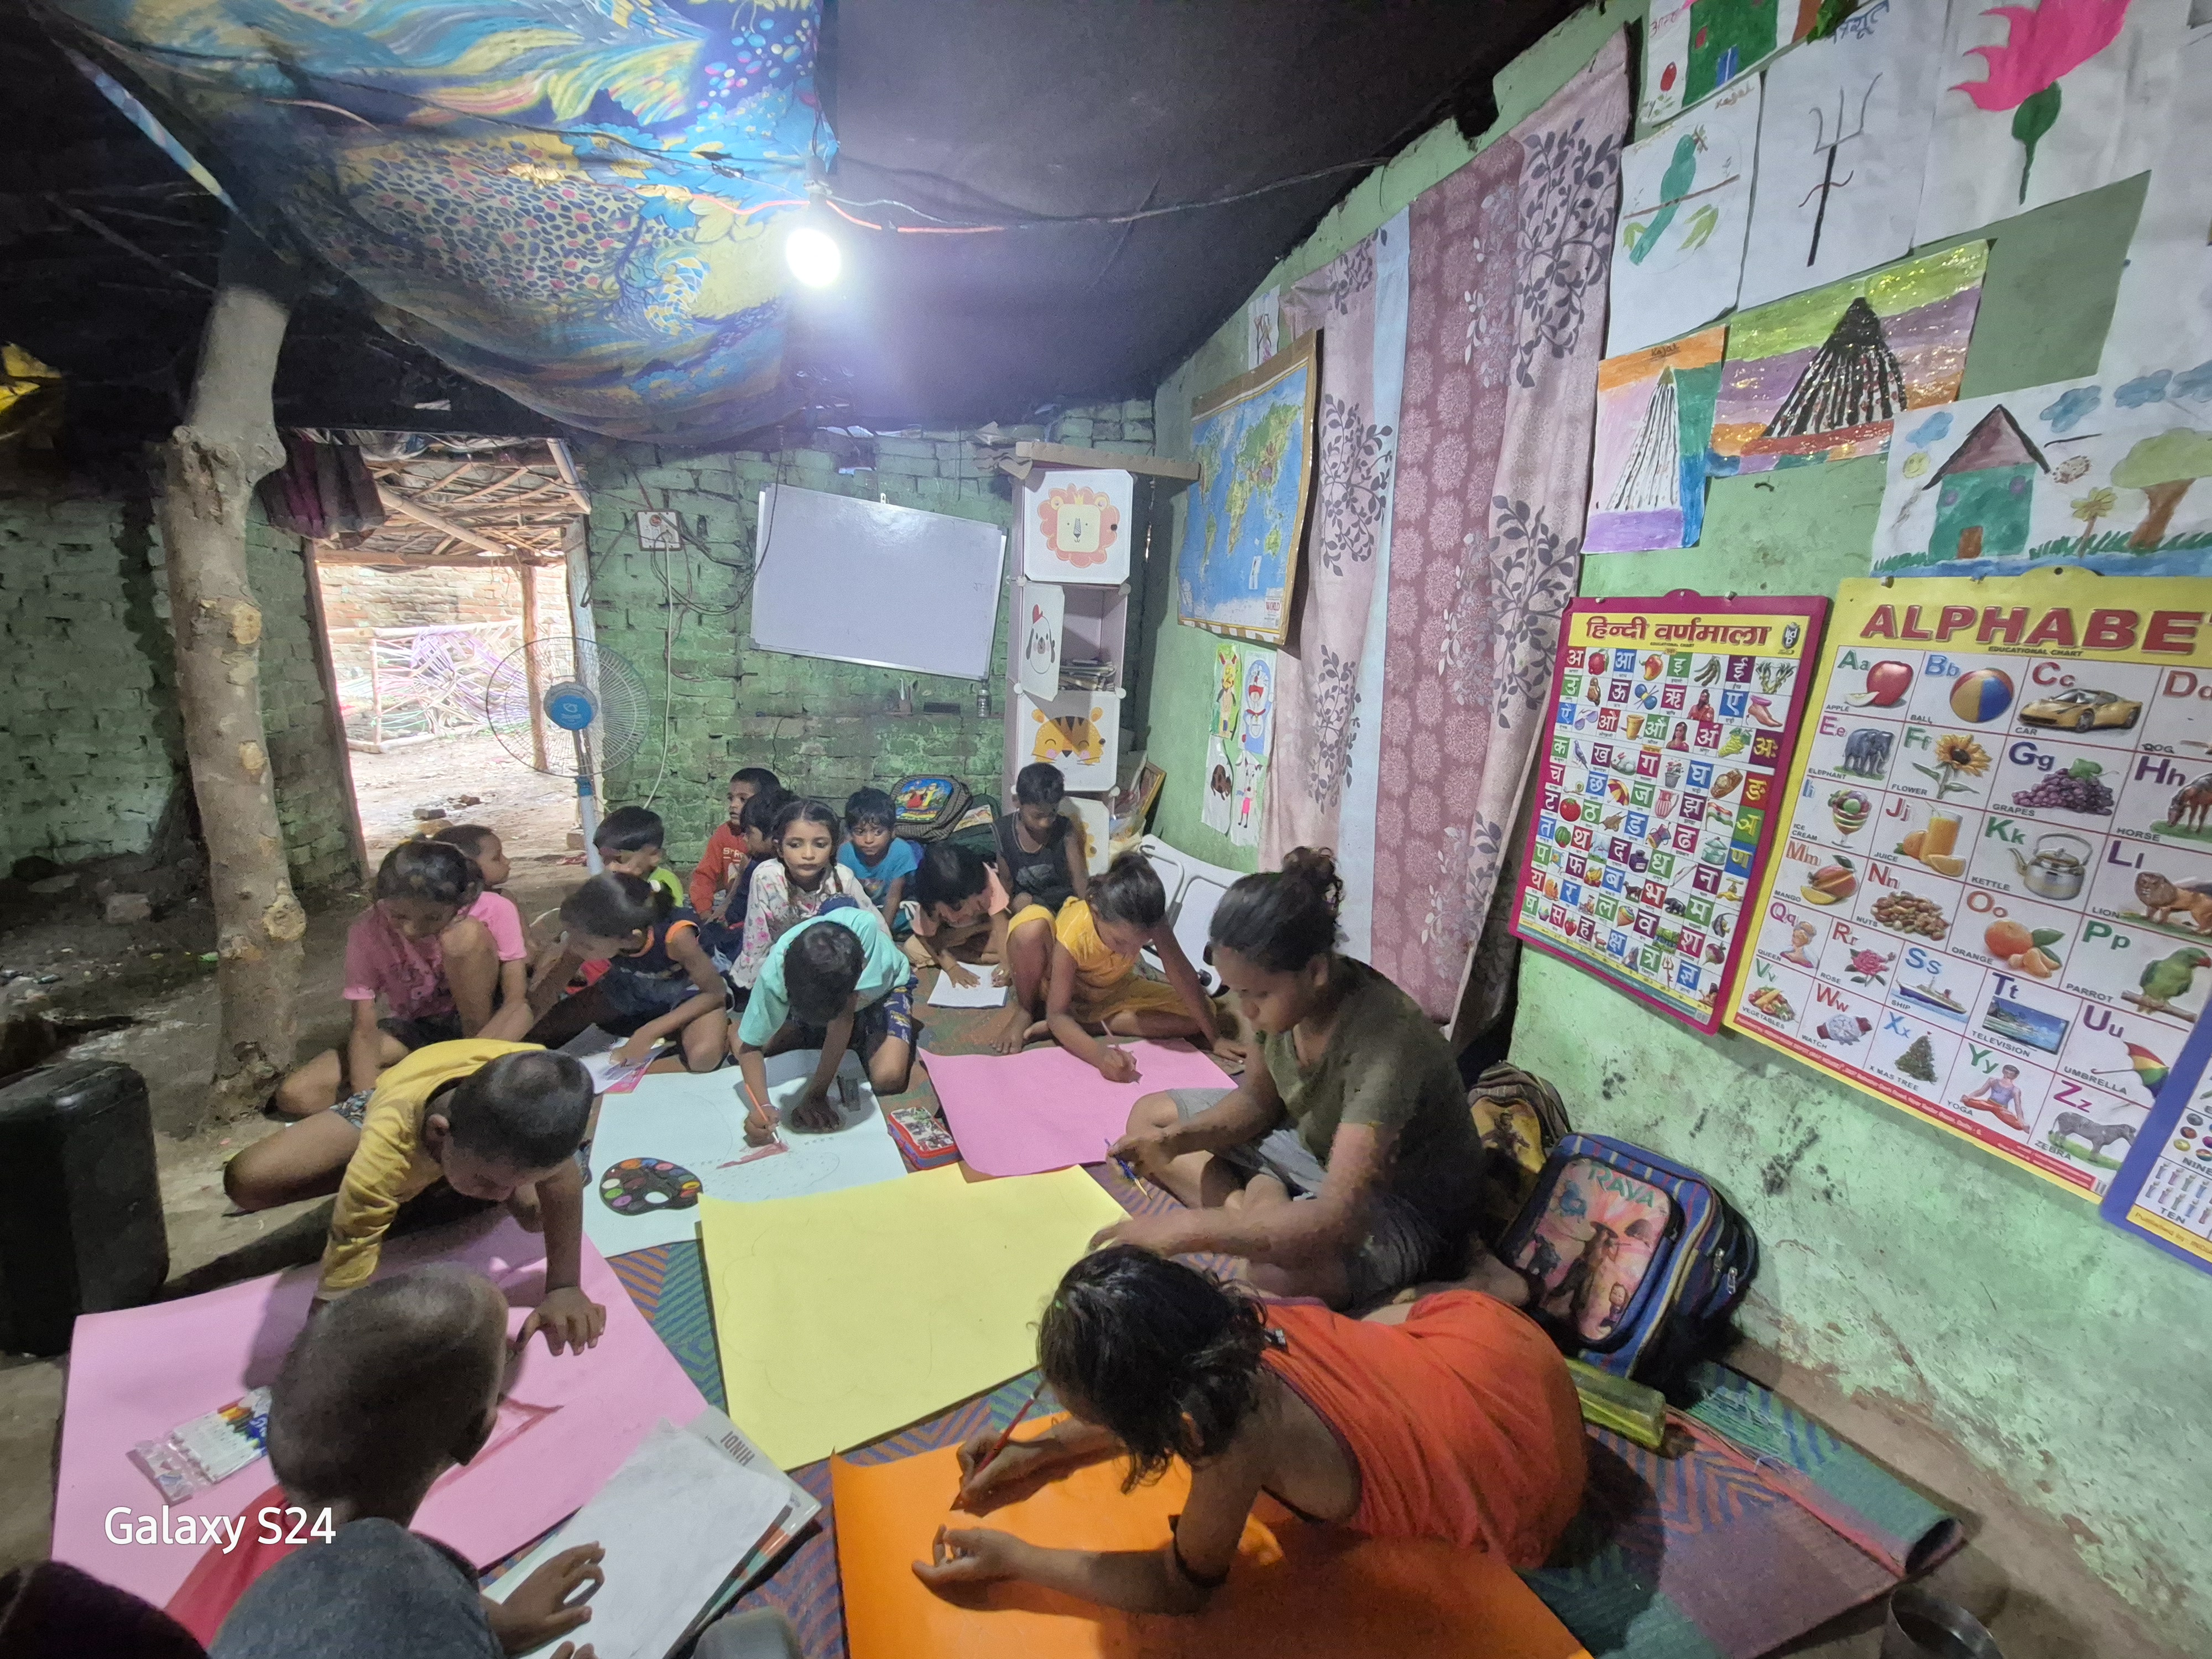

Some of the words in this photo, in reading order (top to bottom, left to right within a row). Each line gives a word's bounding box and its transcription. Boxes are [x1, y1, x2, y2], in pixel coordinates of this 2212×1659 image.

[1586, 616, 1650, 640] हिन्दी
[1654, 617, 1772, 646] वर्णमाला
[1859, 604, 2212, 654] ALPHABE
[1567, 650, 1584, 666] अ
[1615, 652, 1635, 670] आ
[1837, 649, 1870, 671] Aa
[1989, 646, 2048, 655] EDUCATIONAL
[1673, 658, 1686, 676] इ
[1733, 657, 1748, 681] ई
[1925, 655, 1961, 678] Bb
[2032, 662, 2075, 687] Cc
[1564, 676, 1580, 695] उ
[1612, 681, 1630, 701] ऊ
[1665, 688, 1685, 709] ऋ
[1725, 692, 1744, 716] ए
[1819, 716, 1846, 737] Ee
[1911, 714, 1933, 724] BALL
[1697, 724, 1719, 747] अं
[1904, 727, 1933, 750] Ff
[2015, 727, 2038, 735] CAR
[1553, 738, 1568, 754] क
[1594, 746, 1611, 763] ख
[1754, 737, 1778, 758] अः
[2009, 742, 2055, 771] Gg
[2141, 743, 2174, 754] DOG
[1549, 765, 1563, 782] च
[1641, 754, 1658, 774] ग
[1691, 764, 1712, 785] घ
[1808, 768, 1846, 780] ELEPHANT
[2135, 755, 2187, 787] Hh
[1589, 774, 1607, 792] छ
[1745, 778, 1767, 801] ङ
[1891, 784, 1928, 796] FLOWER
[1545, 792, 1558, 810] ट
[1634, 784, 1653, 805] ज
[1584, 802, 1600, 821] ठ
[1682, 796, 1704, 817] झ
[1886, 797, 1911, 822] Jj
[1992, 804, 2035, 817] GRAPES
[1540, 817, 1554, 837] त
[1627, 814, 1646, 835] ड
[1737, 814, 1762, 836] ञ
[1984, 816, 2026, 845] Kk
[2116, 827, 2161, 842] HORSE
[1573, 829, 1590, 849] थ
[1677, 827, 1697, 849] ढ
[1792, 830, 1818, 841] CREAM
[1536, 843, 1548, 862] प
[1614, 840, 1628, 862] द
[1730, 847, 1753, 869] ण
[1786, 840, 1820, 867] Mm
[1874, 852, 1898, 862] JUICE
[1569, 855, 1585, 874] फ
[1652, 853, 1672, 876] ध
[1531, 869, 1545, 890] य
[1605, 868, 1623, 889] ब
[1699, 867, 1719, 892] न
[1867, 862, 1899, 889] Nn
[1971, 876, 2011, 892] KETTLE
[1565, 882, 1577, 902] र
[1645, 883, 1666, 905] भ
[1774, 890, 1802, 902] MANGO
[1551, 905, 1564, 925] स
[1598, 896, 1618, 919] ल
[1690, 898, 1712, 922] म
[1770, 901, 1797, 927] Qq
[1966, 890, 2008, 919] Oo
[2091, 906, 2120, 920] LION
[1579, 918, 1594, 939] ह
[1638, 911, 1658, 936] व
[1856, 916, 1879, 927] NUTS
[1609, 932, 1626, 952] क्ष
[1680, 928, 1704, 953] श
[1832, 921, 1860, 946] Rr
[2081, 920, 2131, 951] Pp
[1643, 946, 1661, 968] त्र
[1757, 948, 1782, 962] QUEEN
[1905, 947, 1942, 975] Ss
[1952, 946, 1995, 966] ORANGE
[1679, 962, 1699, 985] ज्ञ
[1756, 957, 1776, 983] Vv
[1820, 972, 1842, 984] ROSE
[1992, 972, 2019, 1000] Tt
[2066, 983, 2114, 1004] PARROT
[1816, 982, 1850, 1013] Ww
[1891, 999, 1911, 1011] SHIP
[1742, 1005, 1785, 1029] VEGETABLES
[1884, 1010, 1910, 1039] Xx
[2083, 1004, 2125, 1039] Uu
[1801, 1034, 1828, 1049] WATCH
[1972, 1030, 2031, 1058] TELEVISION
[1968, 1042, 2000, 1074] Yy
[1876, 1067, 1895, 1081] MAS
[1897, 1077, 1919, 1092] TREE
[2063, 1065, 2127, 1095] UMBRELLA
[2053, 1079, 2093, 1113] Zz
[1947, 1100, 1974, 1117] YOGA
[2033, 1140, 2072, 1161] ZEBRA
[2182, 1156, 2212, 1177] NINE
[2160, 1207, 2185, 1224] TEN
[720, 1431, 755, 1467] HINDI
